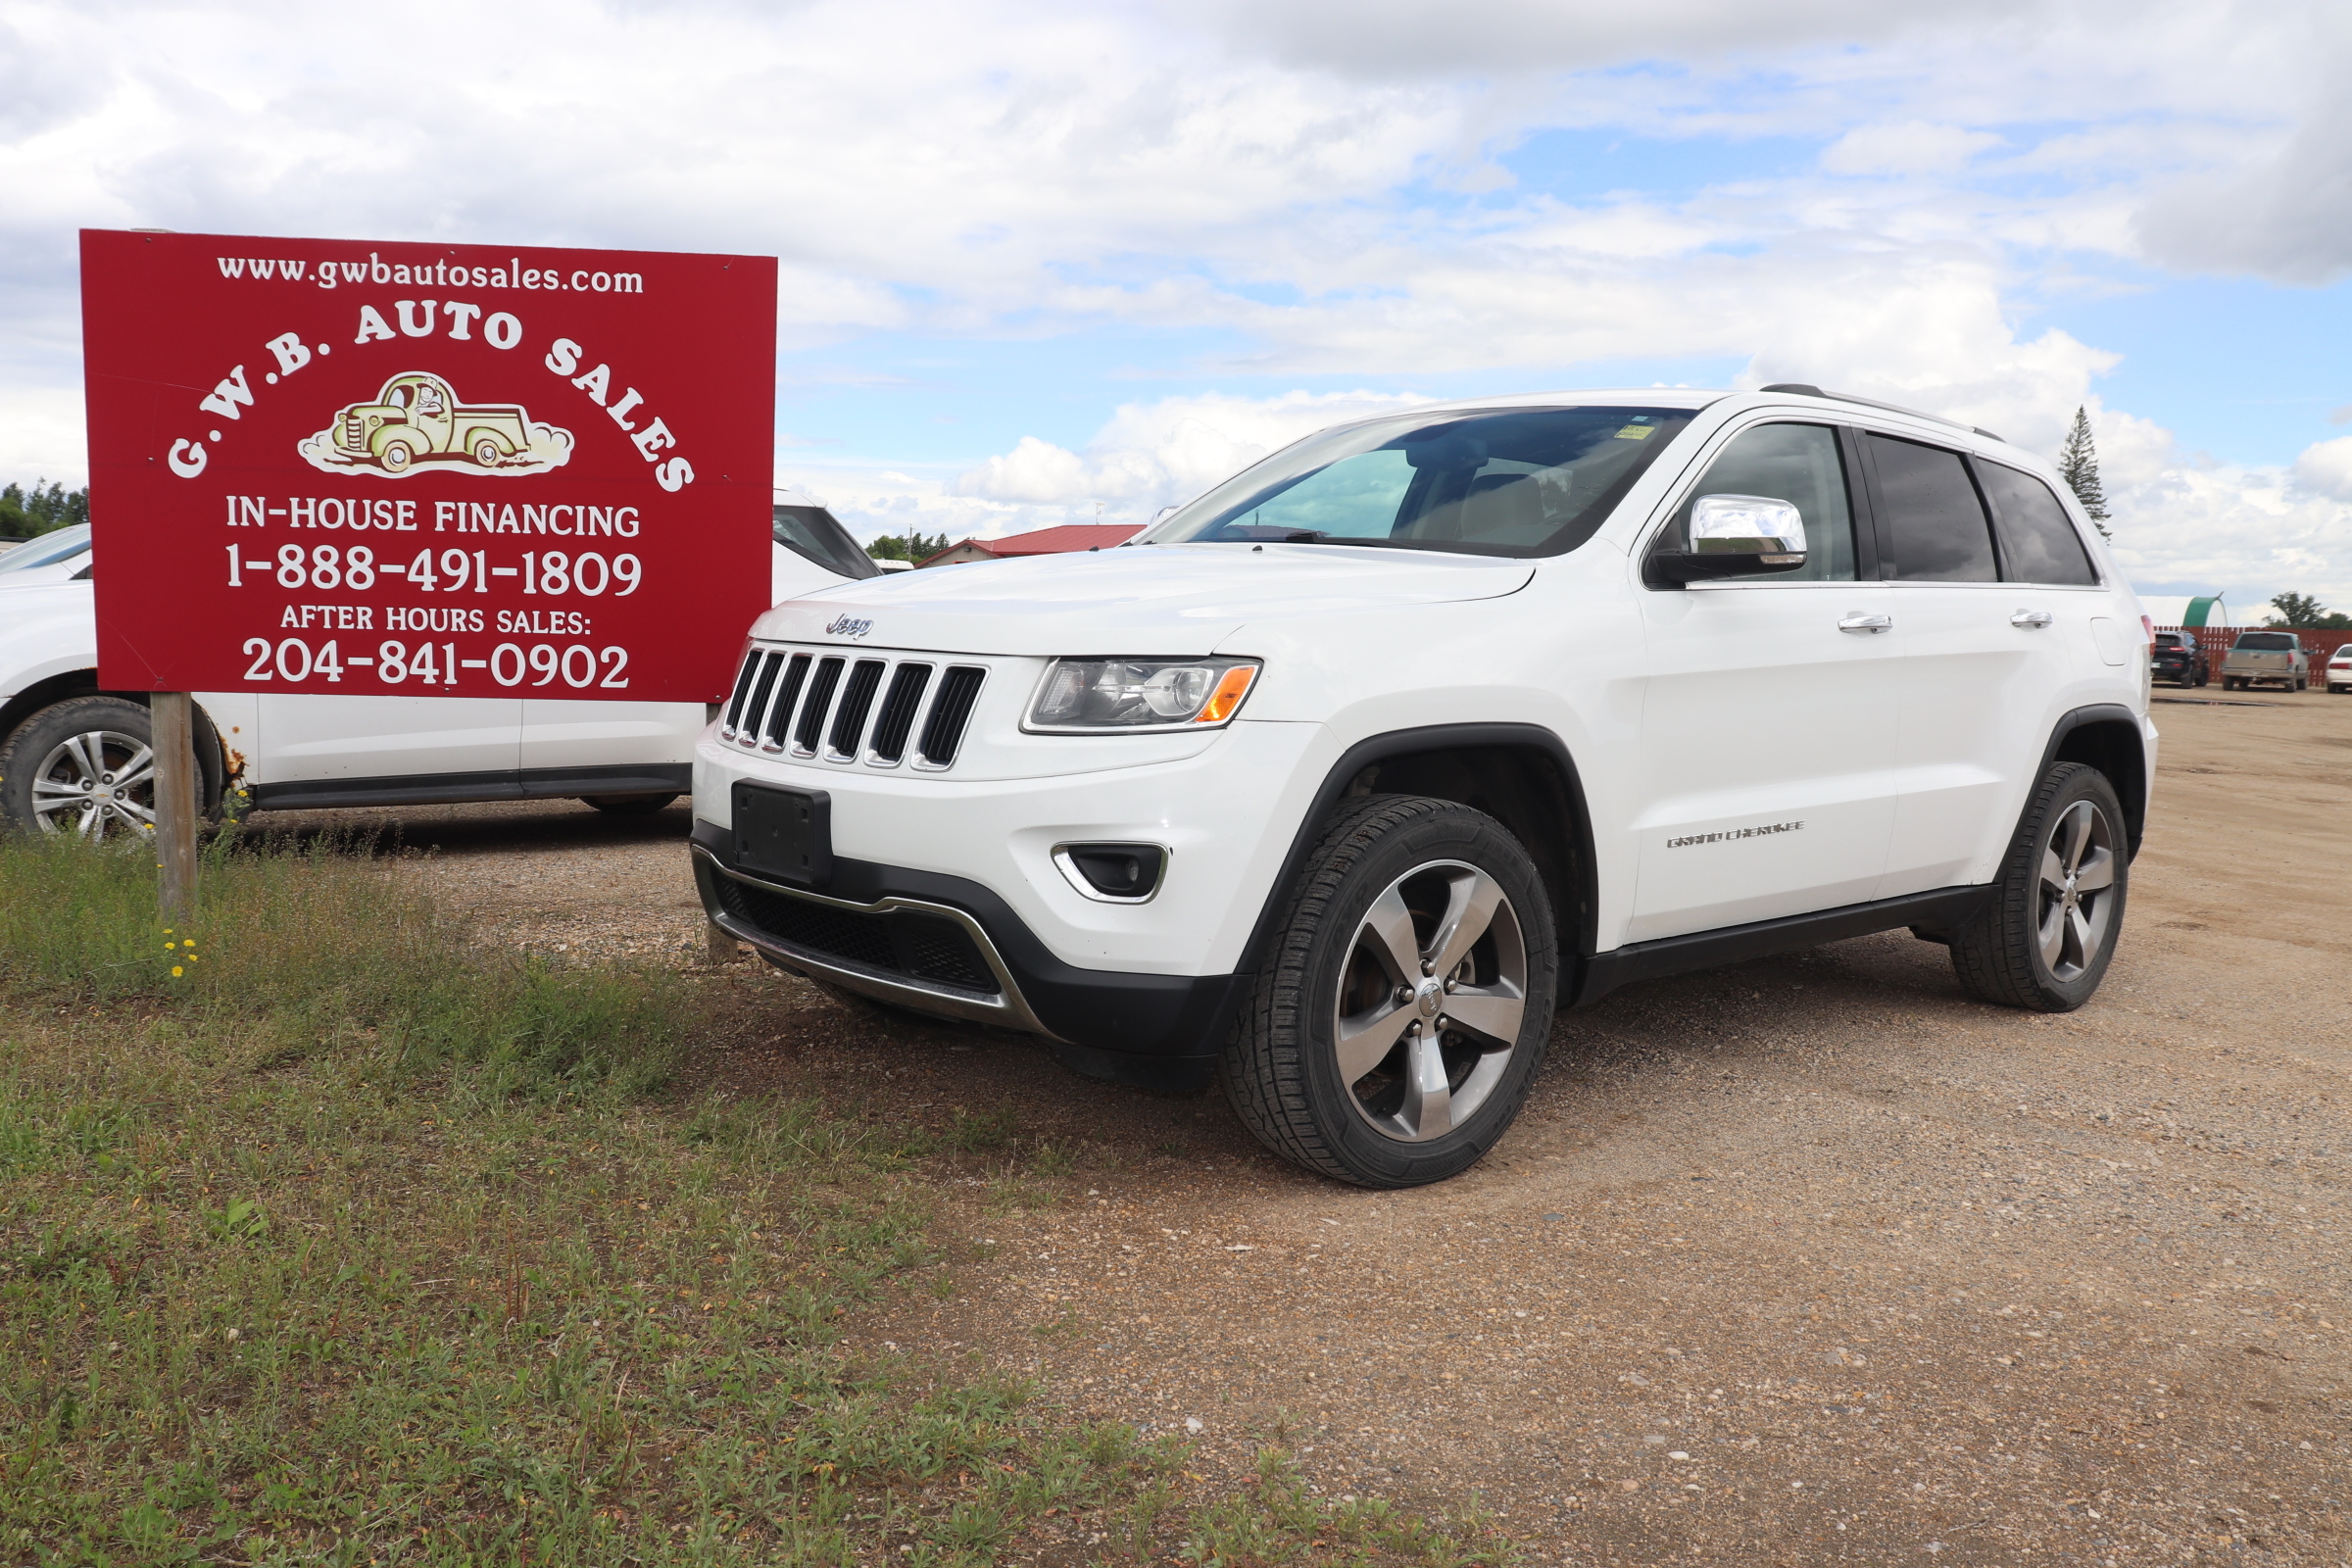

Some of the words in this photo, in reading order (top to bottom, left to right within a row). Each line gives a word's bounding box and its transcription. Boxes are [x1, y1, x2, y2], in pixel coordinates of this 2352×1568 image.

[217, 253, 644, 294] www.gwbautosales.com
[354, 299, 523, 351] AUTO
[544, 337, 695, 493] SALES
[225, 495, 418, 532] IN-HOUSE
[434, 501, 640, 538] FINANCING
[224, 542, 642, 597] 1-888-491-1809
[279, 604, 374, 631] AFTER
[385, 607, 485, 634] HOURS
[496, 610, 591, 636] SALES:
[826, 612, 874, 640] Jeep
[242, 637, 629, 687] 204-841-0902
[1667, 831, 1723, 848] GRAND
[1726, 819, 1806, 840] CHEROKEE
